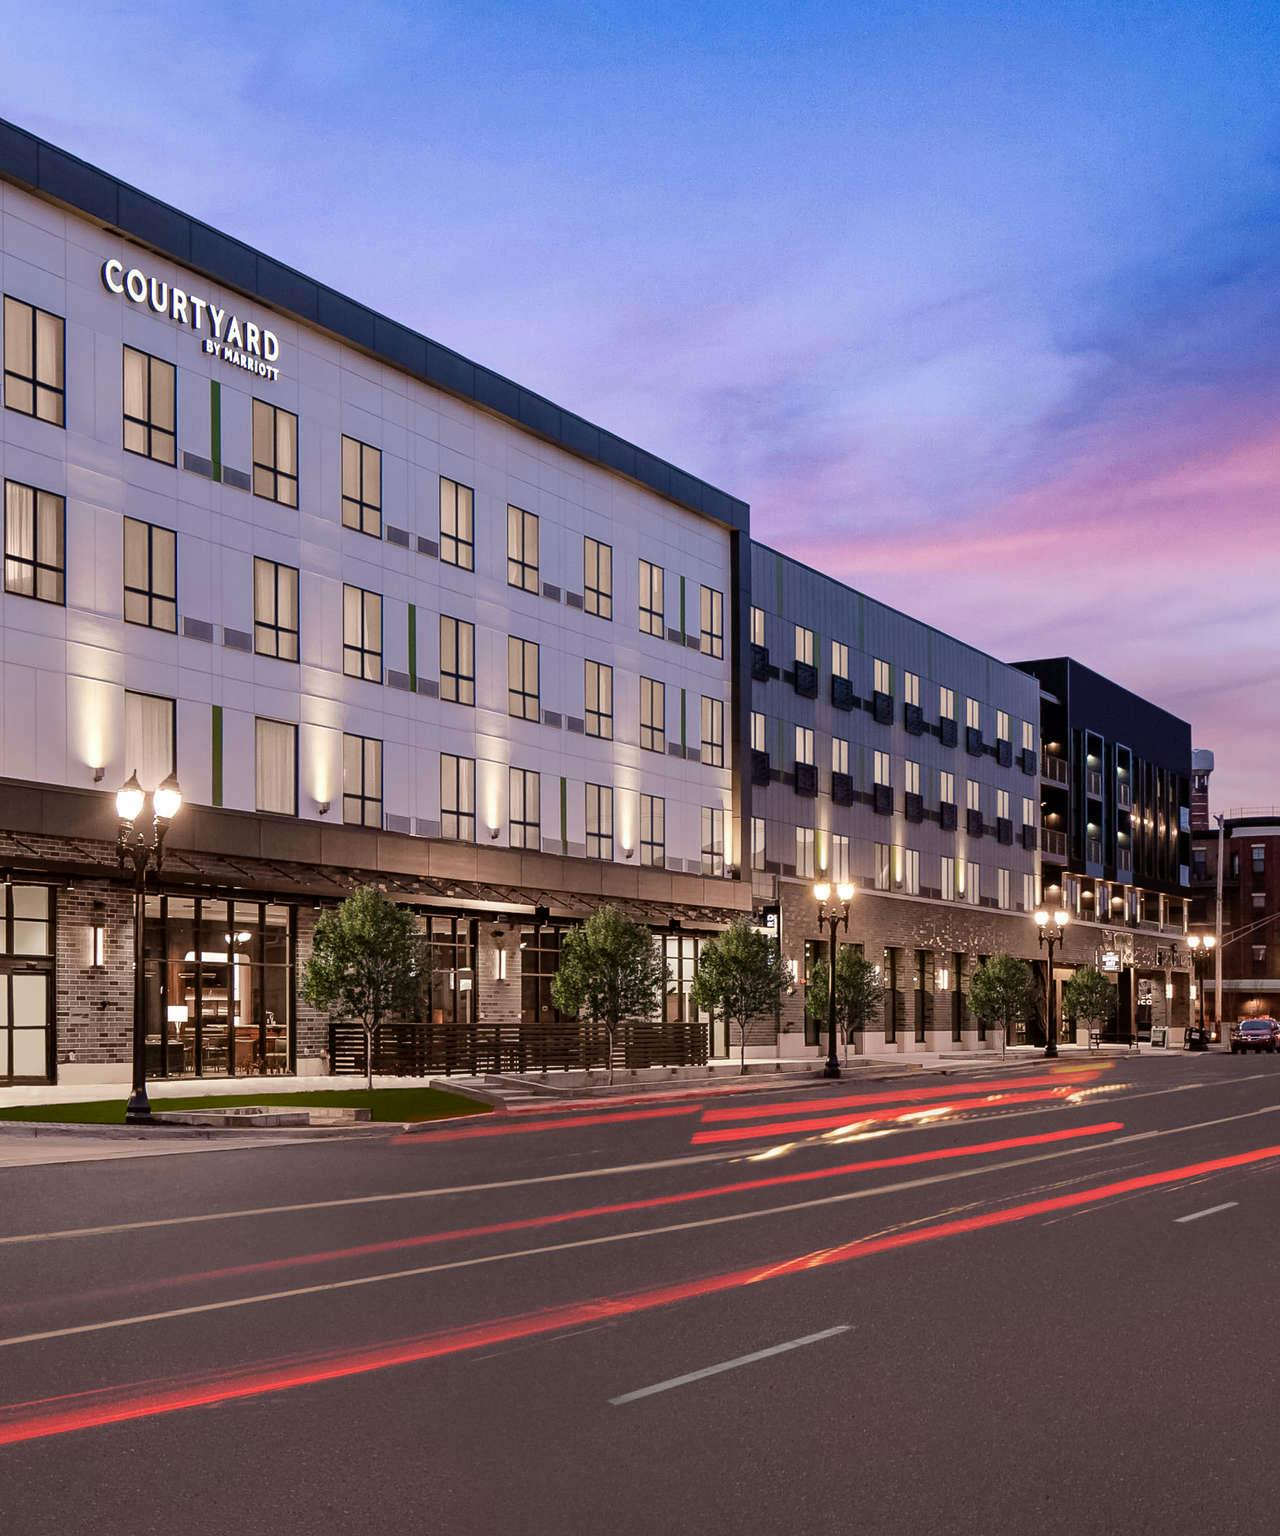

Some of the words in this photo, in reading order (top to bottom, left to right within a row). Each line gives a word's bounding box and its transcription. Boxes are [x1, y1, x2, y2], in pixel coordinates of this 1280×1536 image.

[102, 259, 280, 362] COURTYARD
[205, 339, 221, 356] BY
[223, 346, 280, 381] MARRIOTT
